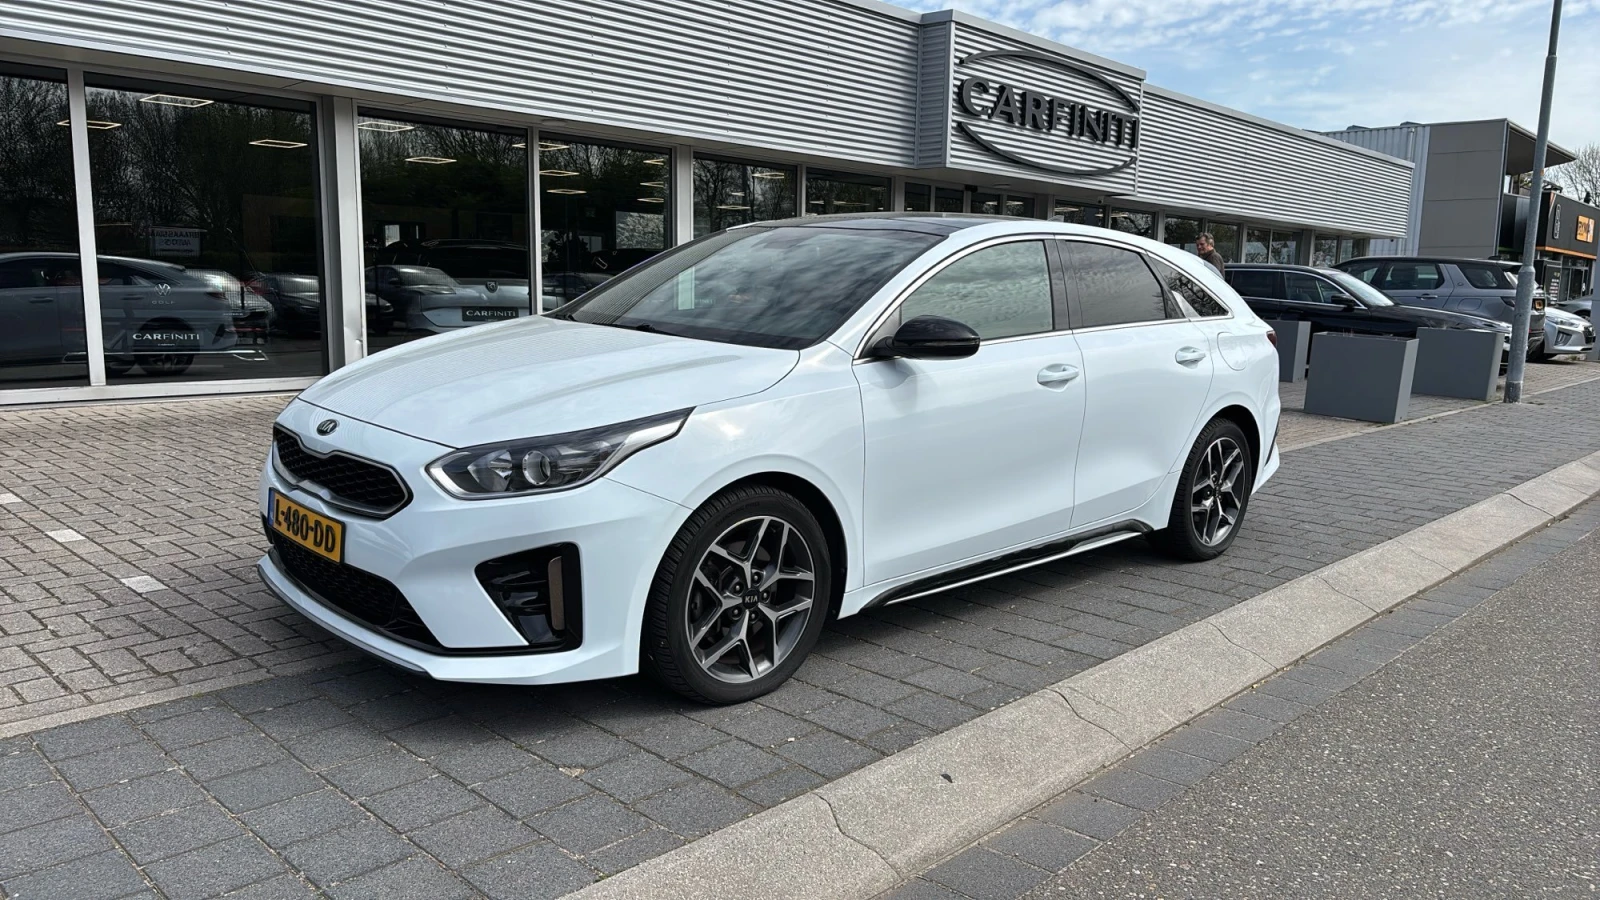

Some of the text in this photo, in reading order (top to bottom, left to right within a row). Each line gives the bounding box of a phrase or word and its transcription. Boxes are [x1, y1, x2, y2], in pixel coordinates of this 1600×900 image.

[958, 76, 1139, 149] CARFINITI
[466, 309, 516, 317] CARFINITI
[275, 498, 337, 553] L-480-DD
[744, 595, 758, 604] KIA
